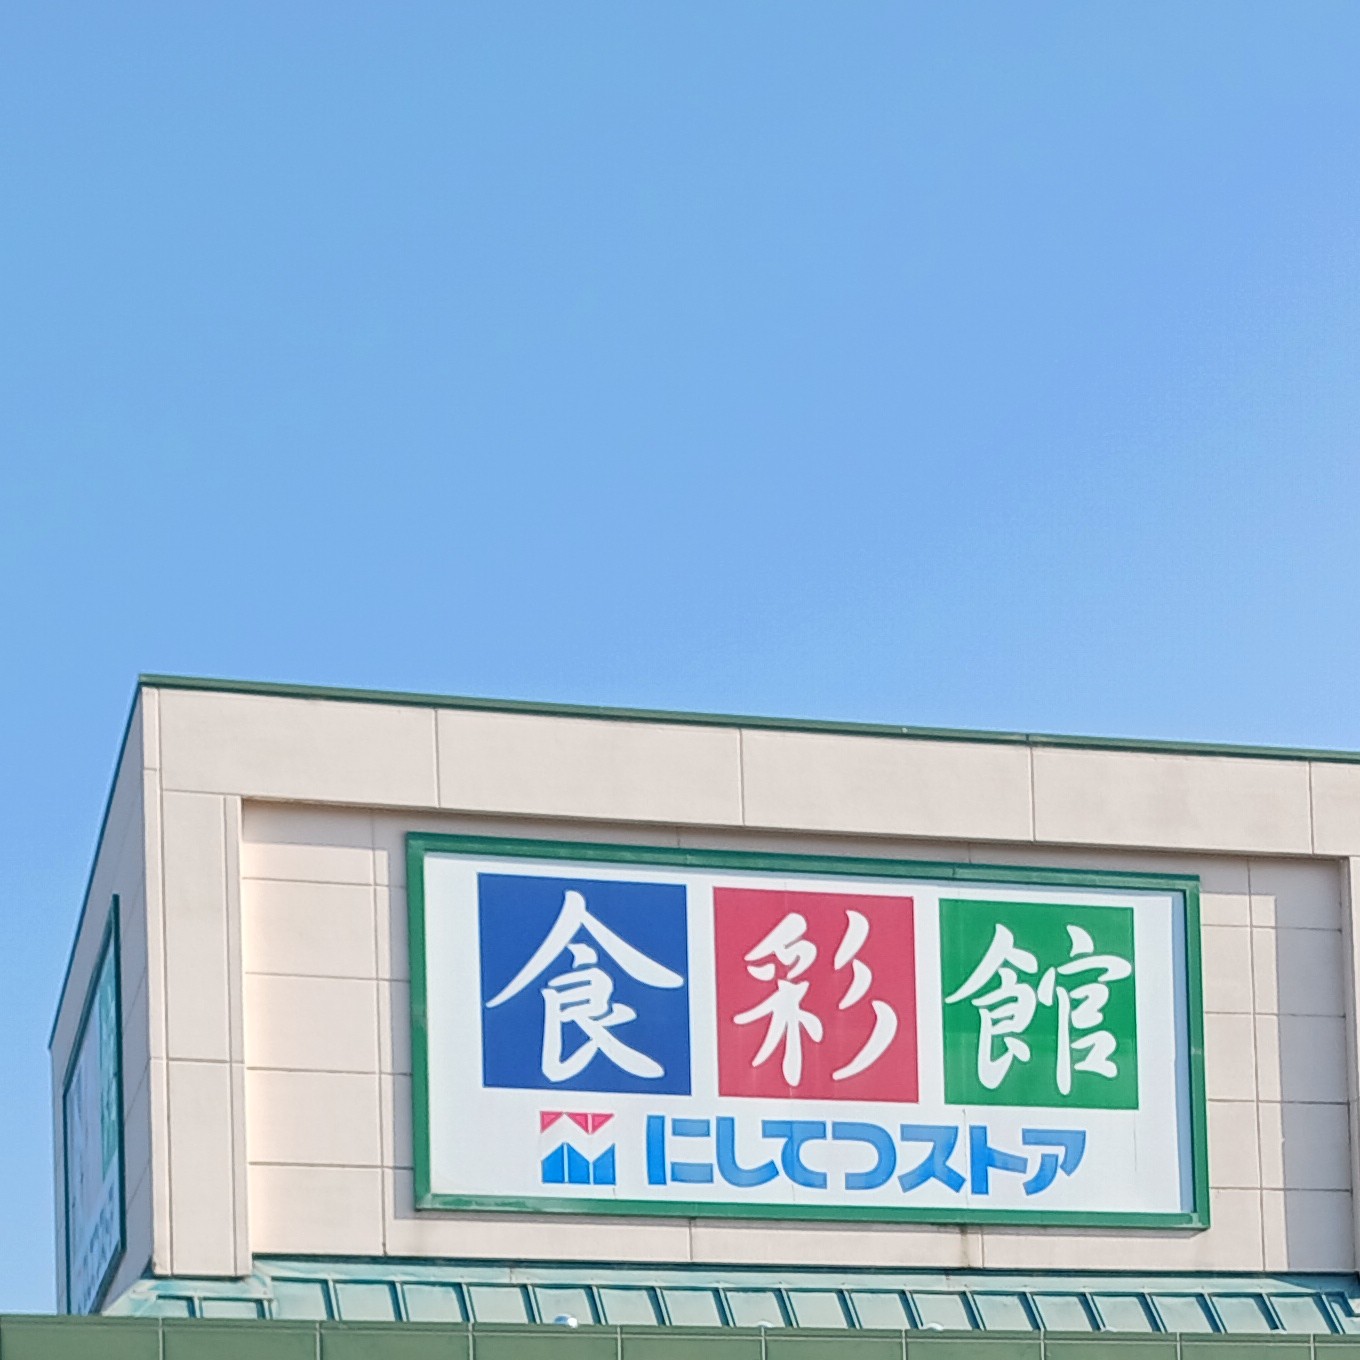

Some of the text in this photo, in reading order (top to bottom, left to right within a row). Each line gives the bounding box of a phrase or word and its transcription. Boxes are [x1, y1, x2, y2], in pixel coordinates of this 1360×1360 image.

[485, 889, 1134, 1096] 食彩館
[646, 1114, 1086, 1195] にしてつストア
